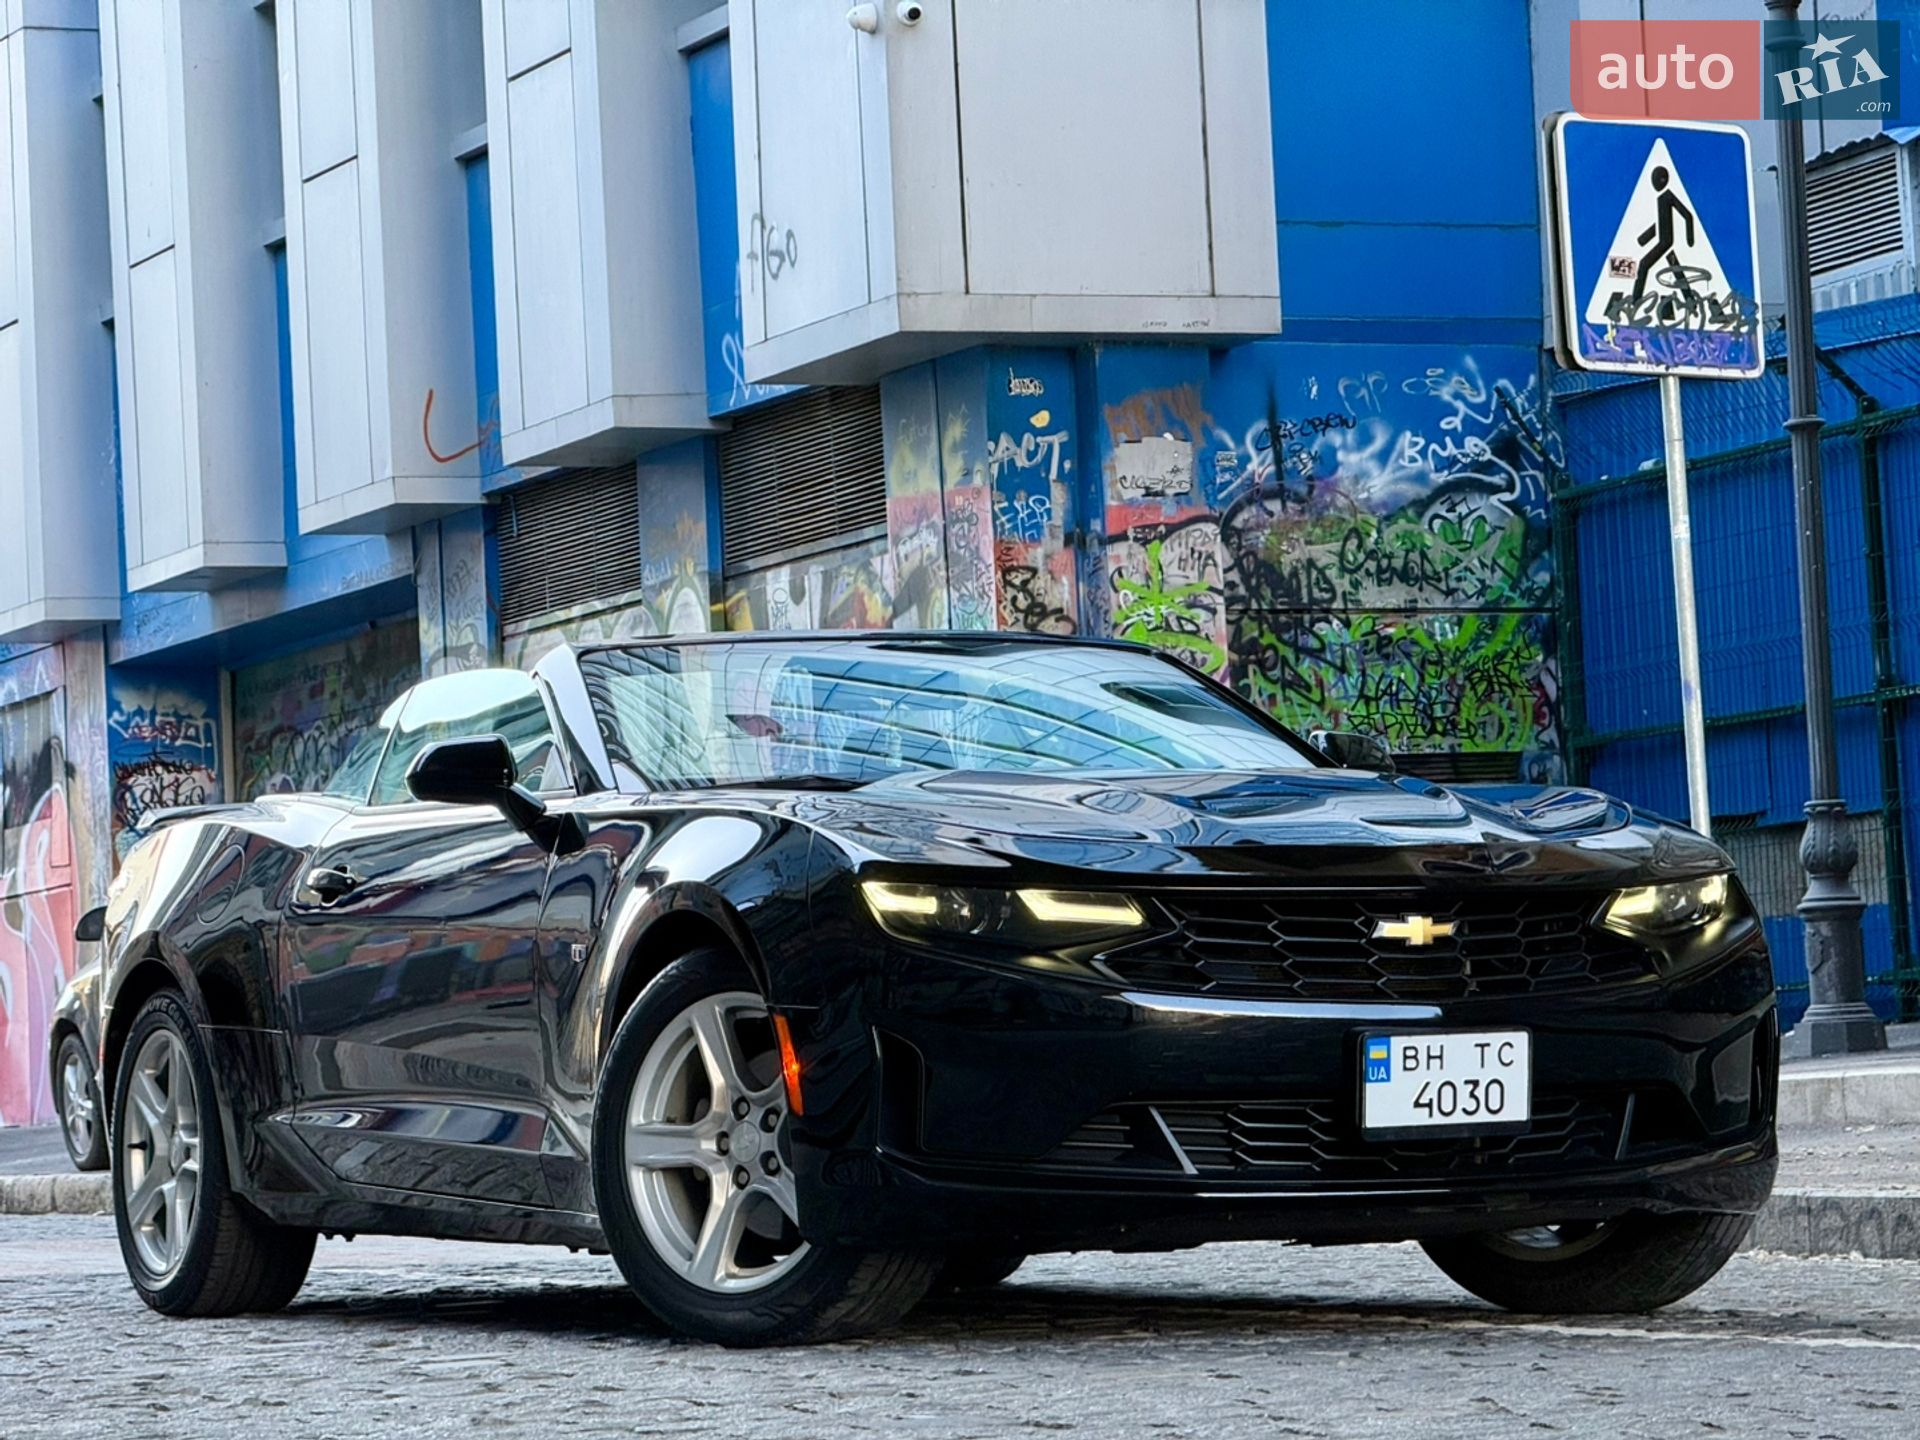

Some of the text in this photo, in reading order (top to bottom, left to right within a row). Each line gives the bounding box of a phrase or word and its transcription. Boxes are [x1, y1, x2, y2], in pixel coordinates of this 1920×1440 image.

[1402, 1041, 1515, 1072] BH TC
[1369, 1066, 1388, 1081] UA
[1413, 1078, 1506, 1119] 4030
